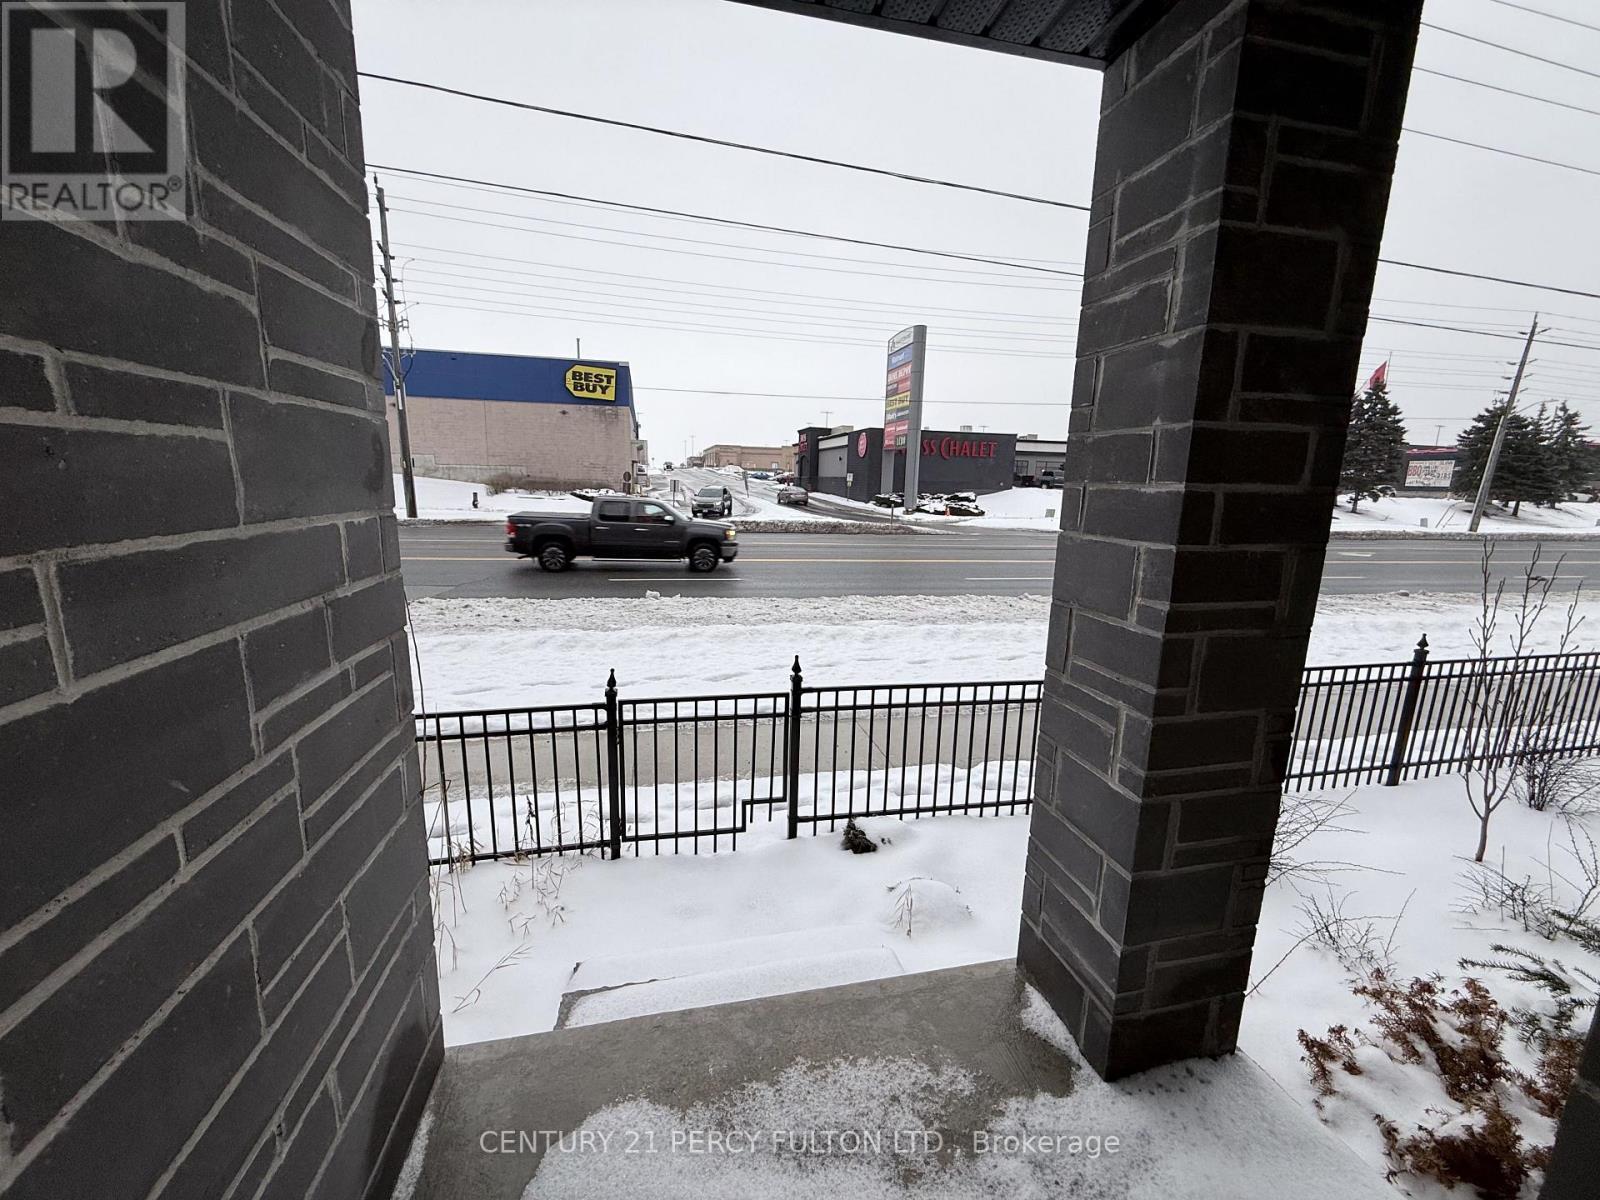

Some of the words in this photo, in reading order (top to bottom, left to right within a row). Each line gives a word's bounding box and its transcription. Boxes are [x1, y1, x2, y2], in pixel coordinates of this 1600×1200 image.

[572, 371, 614, 384] BEST
[574, 382, 609, 394] BUY
[941, 437, 998, 459] CHALET
